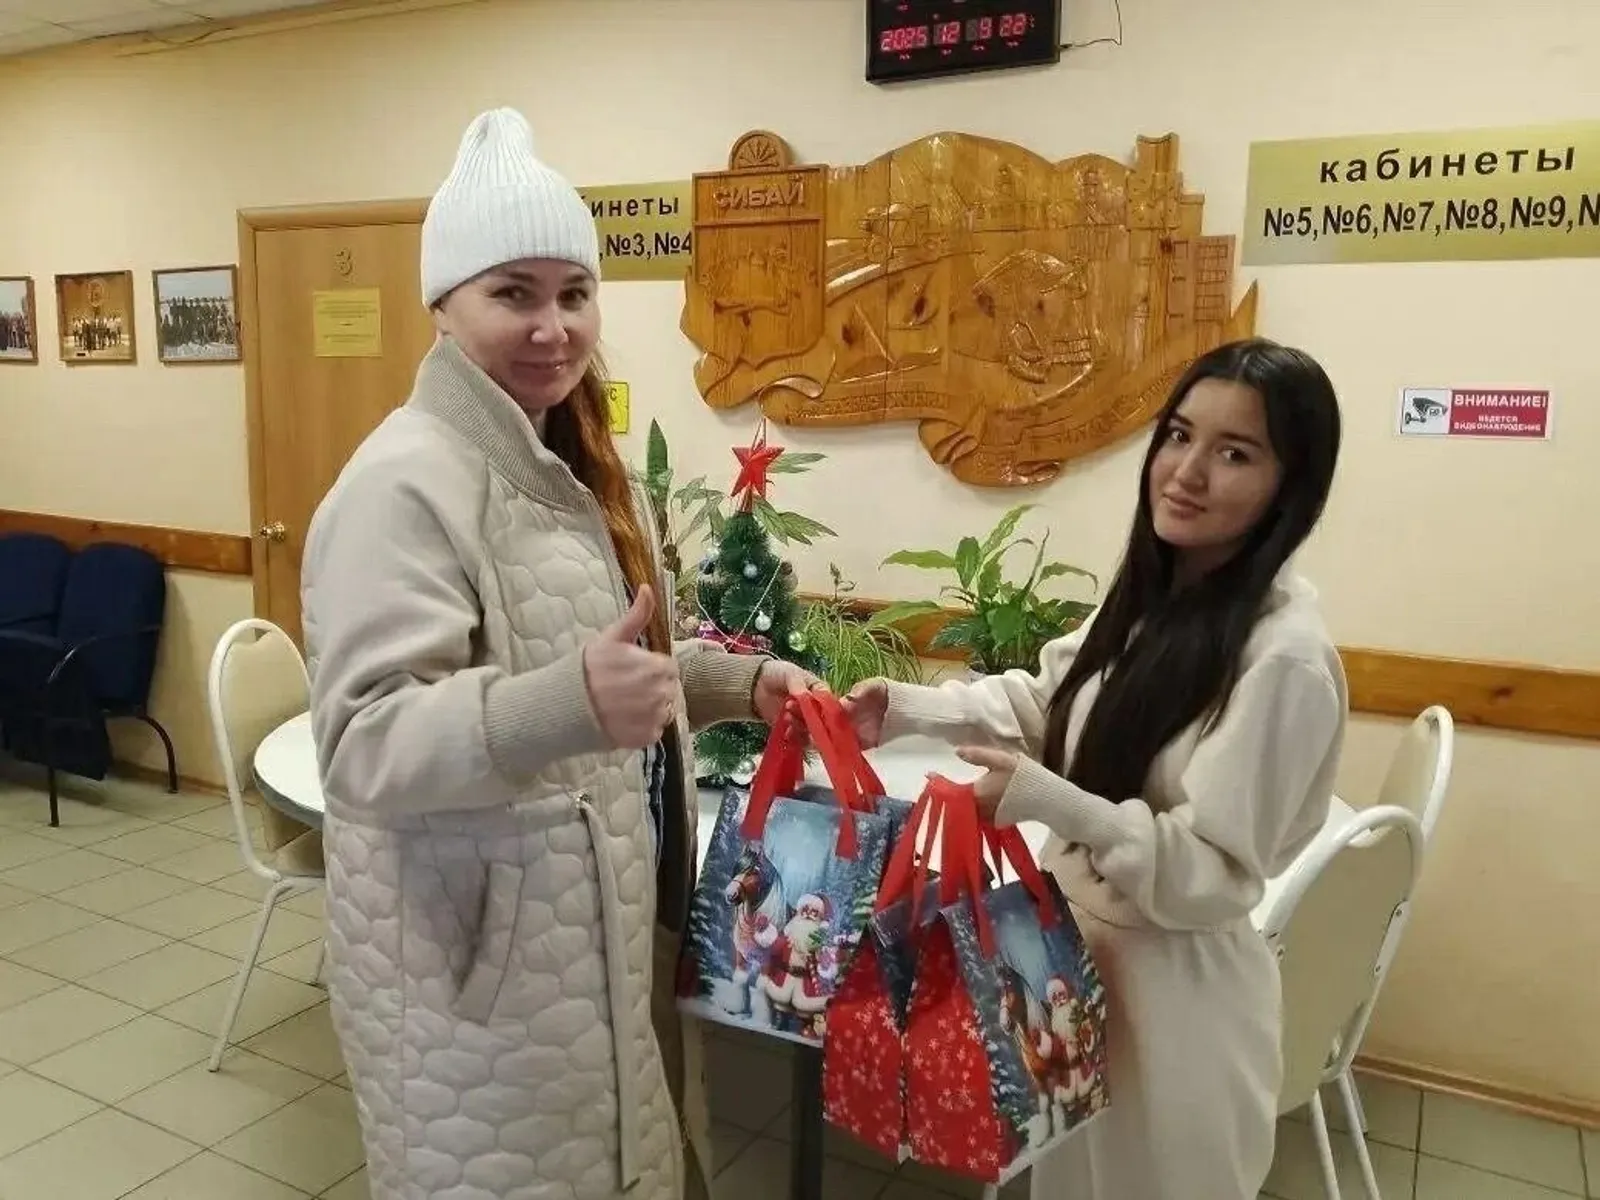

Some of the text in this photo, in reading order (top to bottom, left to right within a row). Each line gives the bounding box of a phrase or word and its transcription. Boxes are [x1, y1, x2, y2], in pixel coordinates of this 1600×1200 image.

[881, 26, 928, 51] 2025
[940, 21, 960, 45] 12
[1319, 146, 1575, 183] кабинеты
[713, 173, 805, 209] СИБАЙ
[581, 195, 679, 218] инеты
[1454, 394, 1546, 408] ВНИМАНИЕ!
[1478, 414, 1519, 423] ВЕДЕТСЯ
